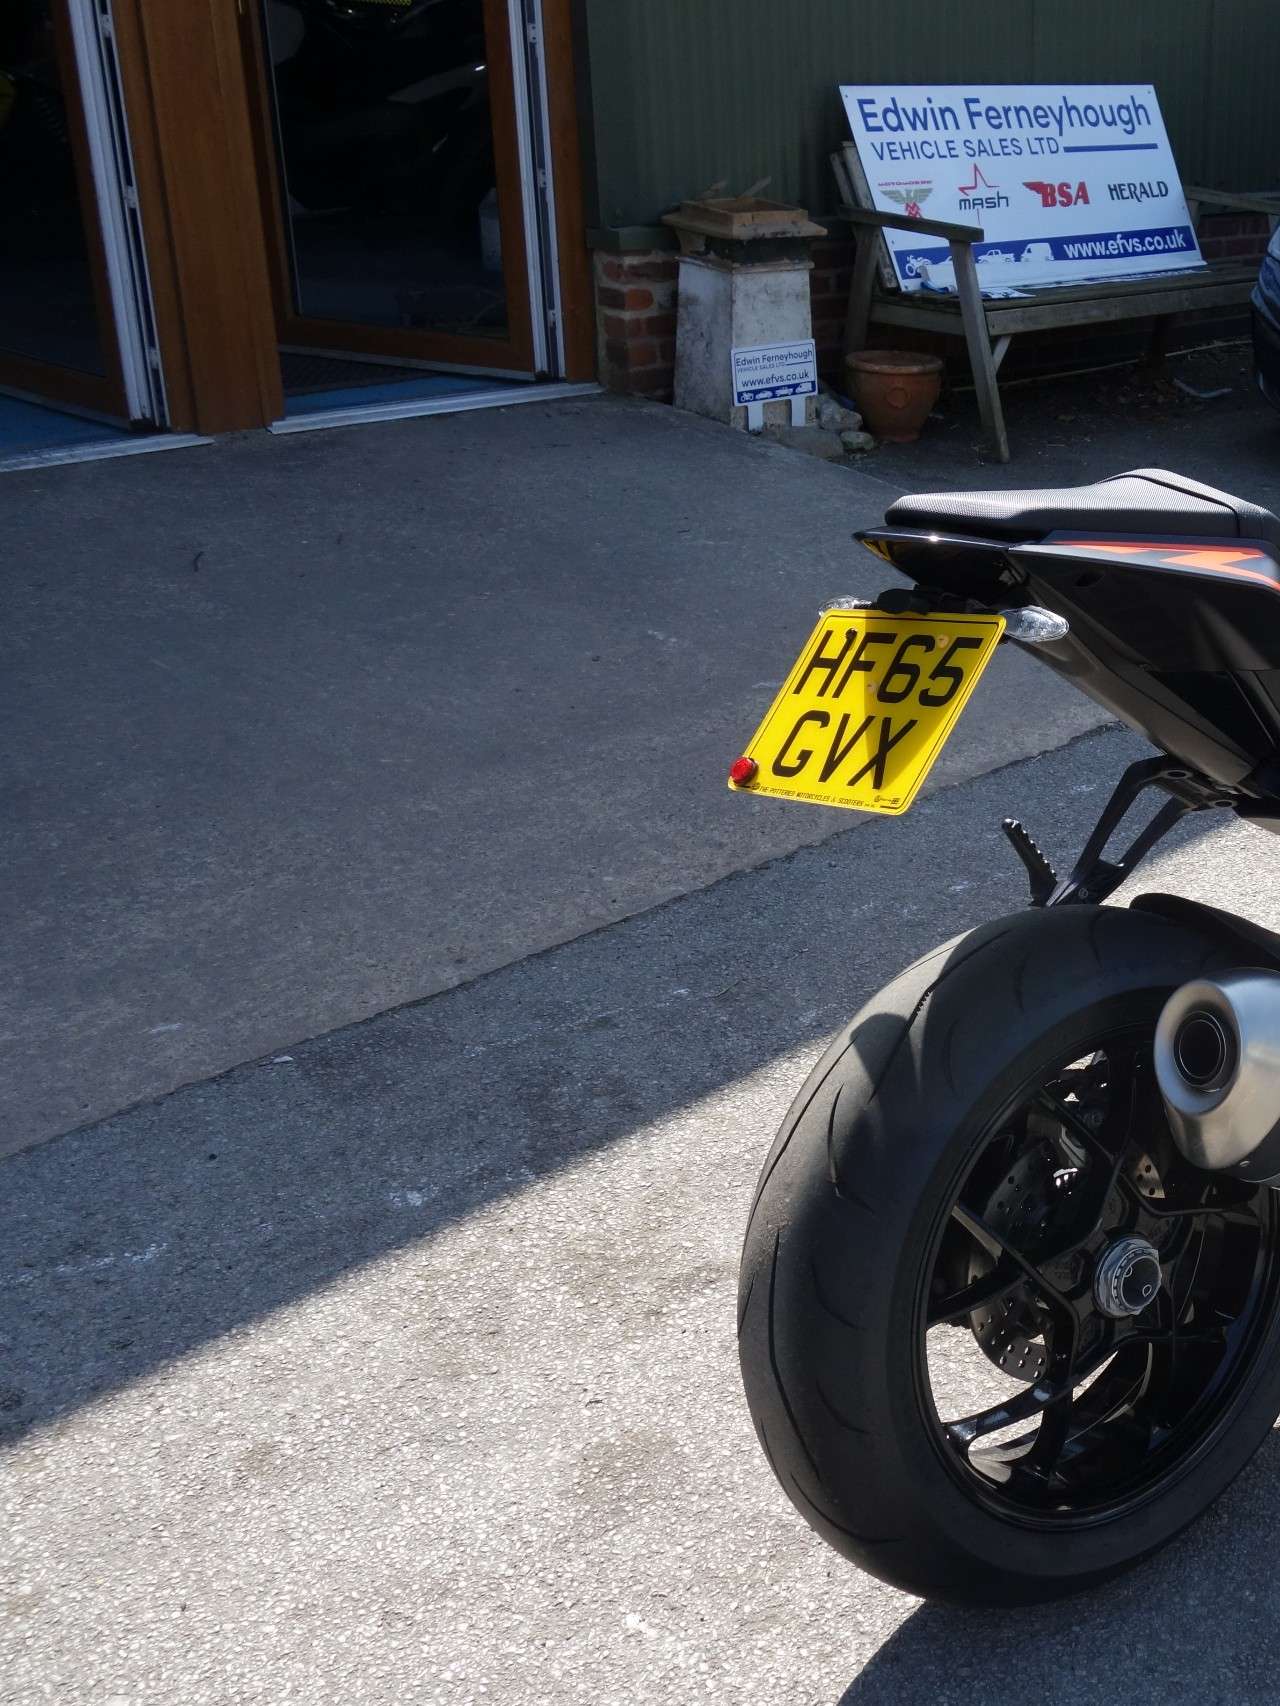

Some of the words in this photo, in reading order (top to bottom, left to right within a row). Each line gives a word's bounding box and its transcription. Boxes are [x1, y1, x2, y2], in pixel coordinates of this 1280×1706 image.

[856, 96, 960, 133] Edwin
[963, 95, 1151, 136] Ferneyhough
[870, 140, 959, 160] VEHICLE
[963, 137, 1023, 158] SALES
[1026, 136, 1059, 155] LTD
[1040, 181, 1090, 208] BSA
[1108, 181, 1169, 202] HERALD
[1063, 230, 1186, 259] www.efvs.co.uk
[736, 356, 760, 367] Edwin
[761, 349, 812, 362] Ferneyhough
[741, 369, 809, 388] www.efvs.co.uk
[792, 629, 984, 708] HF65
[771, 709, 918, 791] GVX
